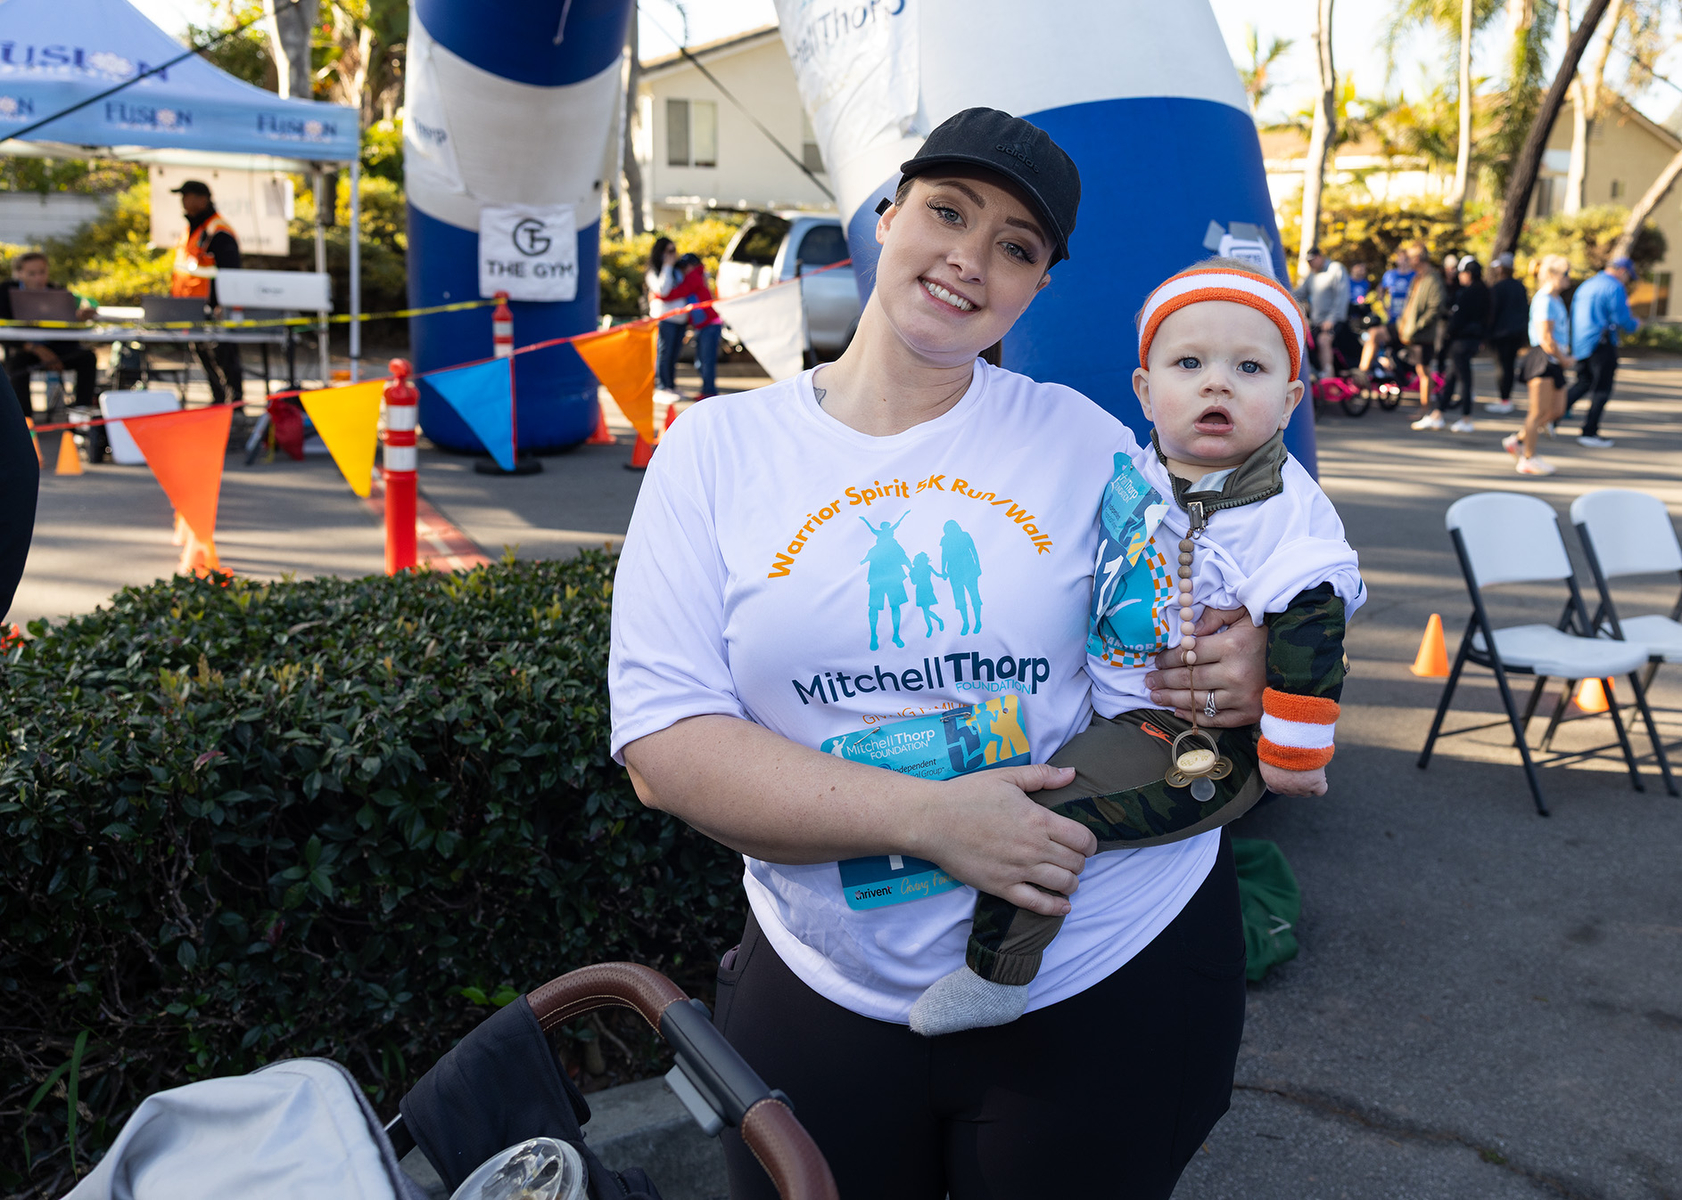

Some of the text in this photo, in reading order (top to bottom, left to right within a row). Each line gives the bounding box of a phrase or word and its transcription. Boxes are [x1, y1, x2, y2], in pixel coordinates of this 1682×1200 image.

[995, 143, 1039, 174] adidas
[485, 259, 575, 279] THE GYM
[767, 473, 1054, 579] Warrior Spirit 5K Run/Walk
[955, 678, 1031, 695] FOUNDATION
[870, 740, 930, 760] FOUNDATION
[900, 877, 929, 896] Giving
